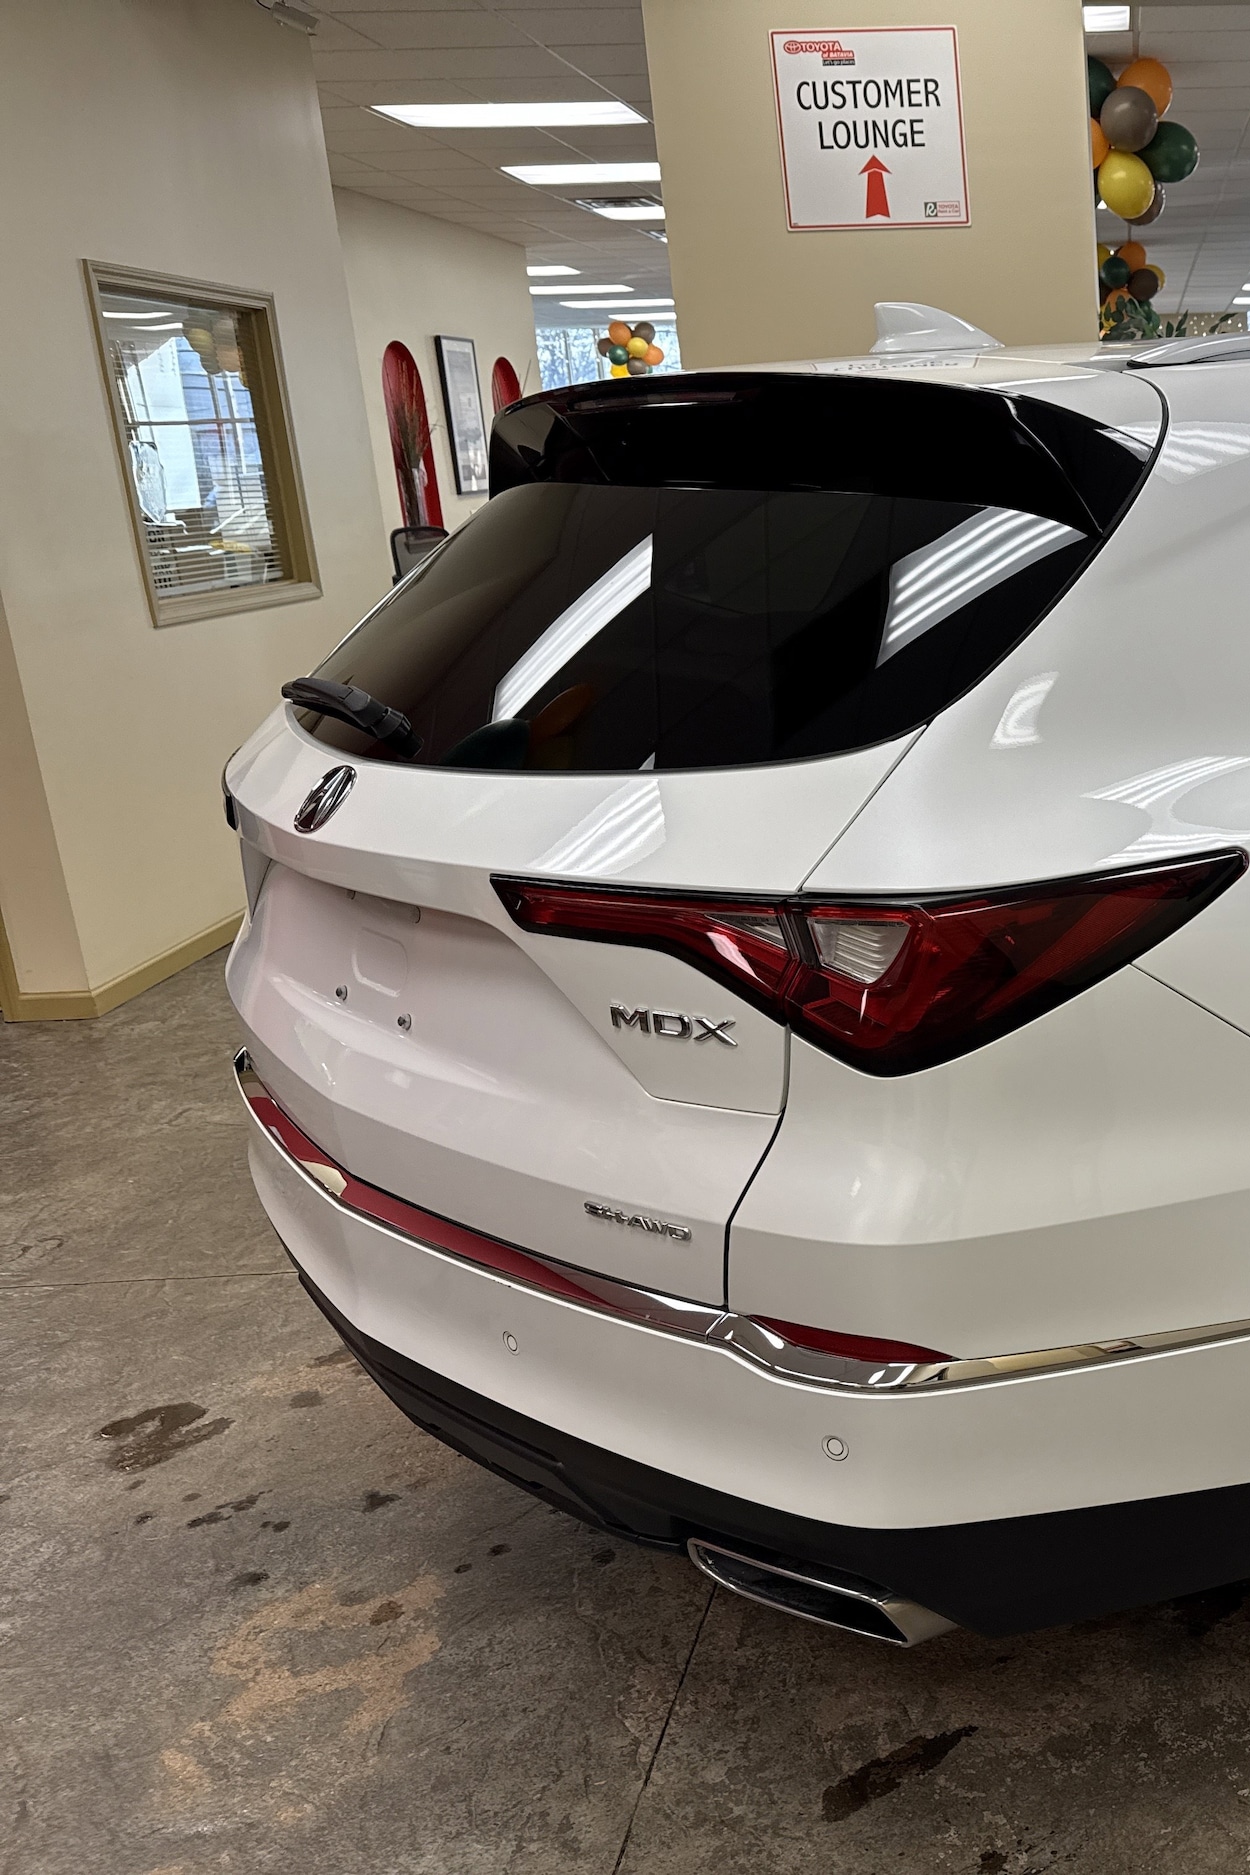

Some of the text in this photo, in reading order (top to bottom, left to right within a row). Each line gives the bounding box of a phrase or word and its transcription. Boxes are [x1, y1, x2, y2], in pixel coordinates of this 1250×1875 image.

[800, 42, 841, 51] TOYOTA
[796, 78, 941, 110] CUSTOMER
[818, 119, 926, 150] LOUNGE
[609, 1002, 738, 1047] MDX
